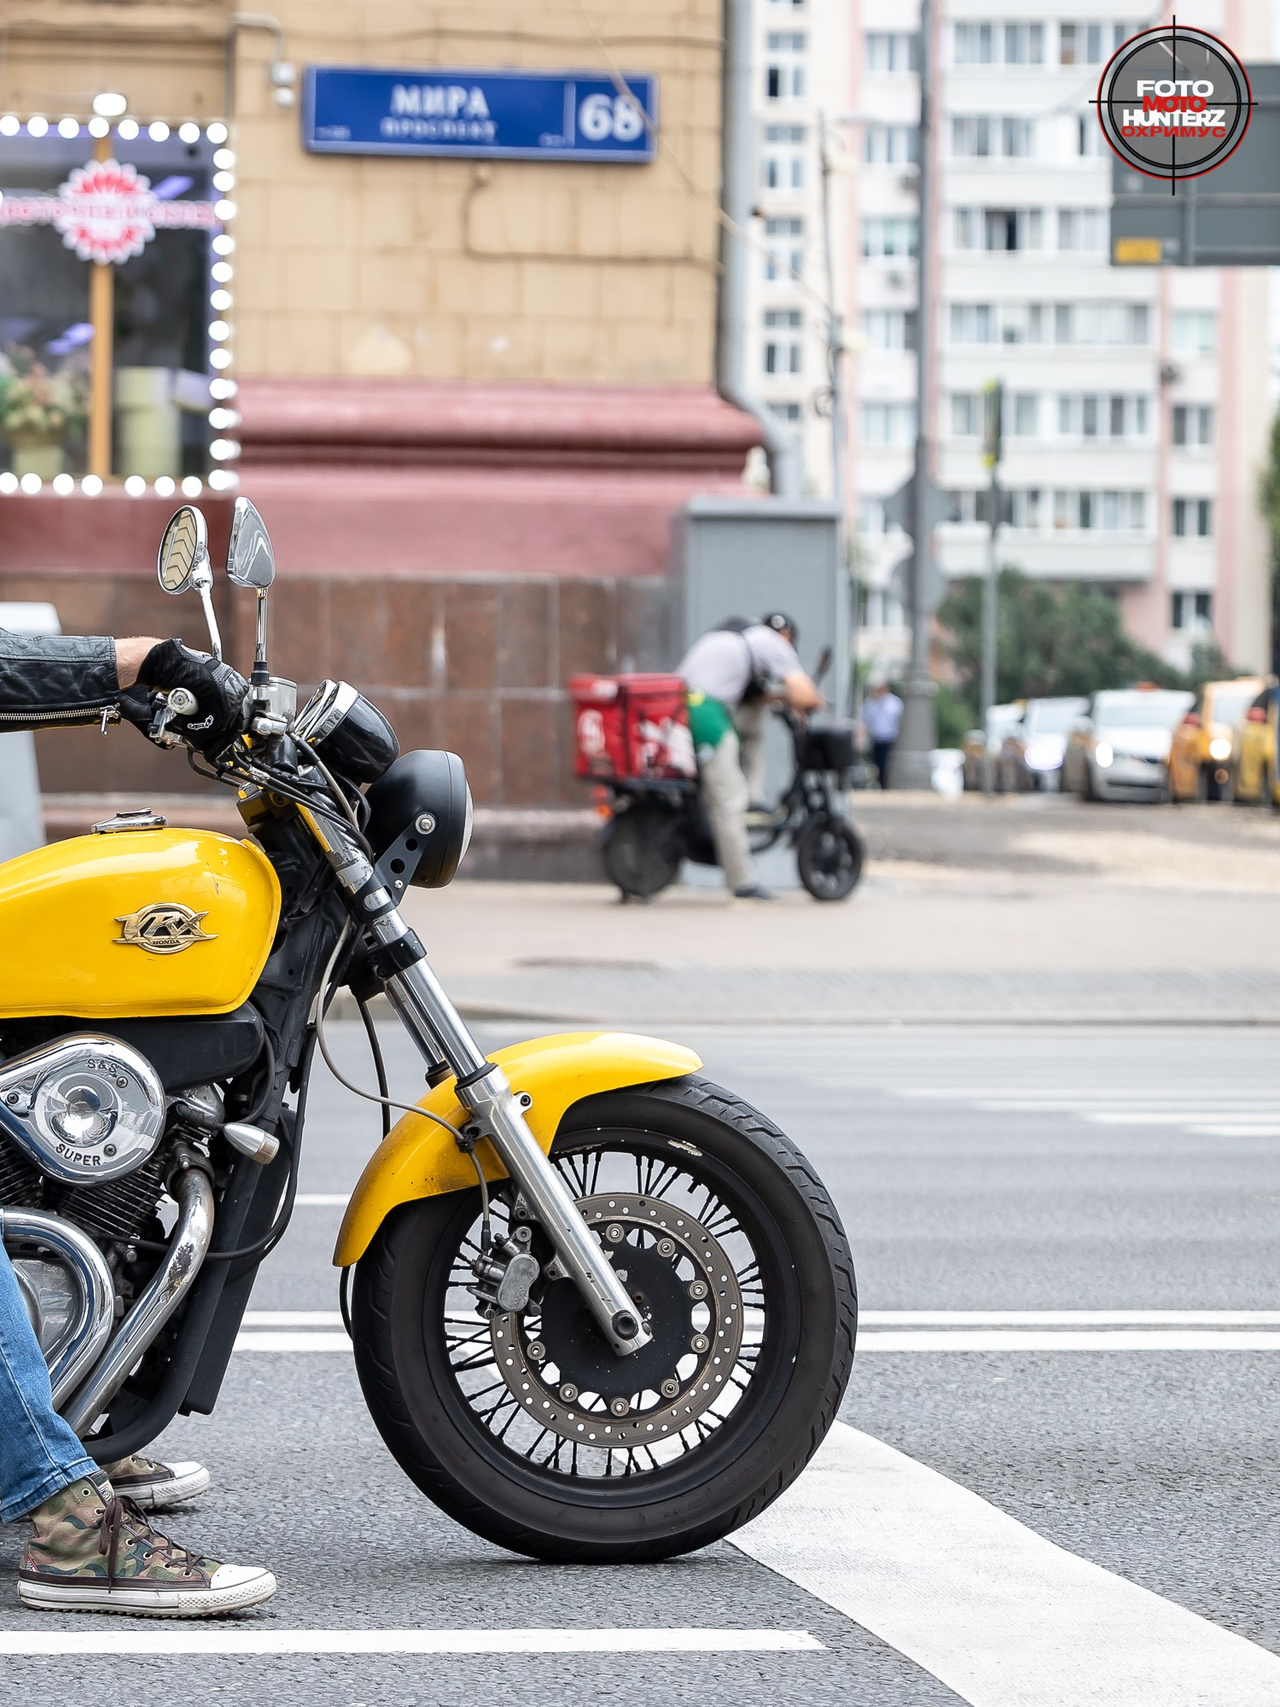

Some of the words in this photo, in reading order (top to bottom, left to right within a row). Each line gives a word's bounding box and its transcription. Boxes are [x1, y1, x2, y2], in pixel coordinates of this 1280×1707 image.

[391, 84, 490, 119] МИРА
[578, 92, 644, 142] 68
[113, 910, 210, 942] VRX
[55, 1143, 101, 1166] SUPER
